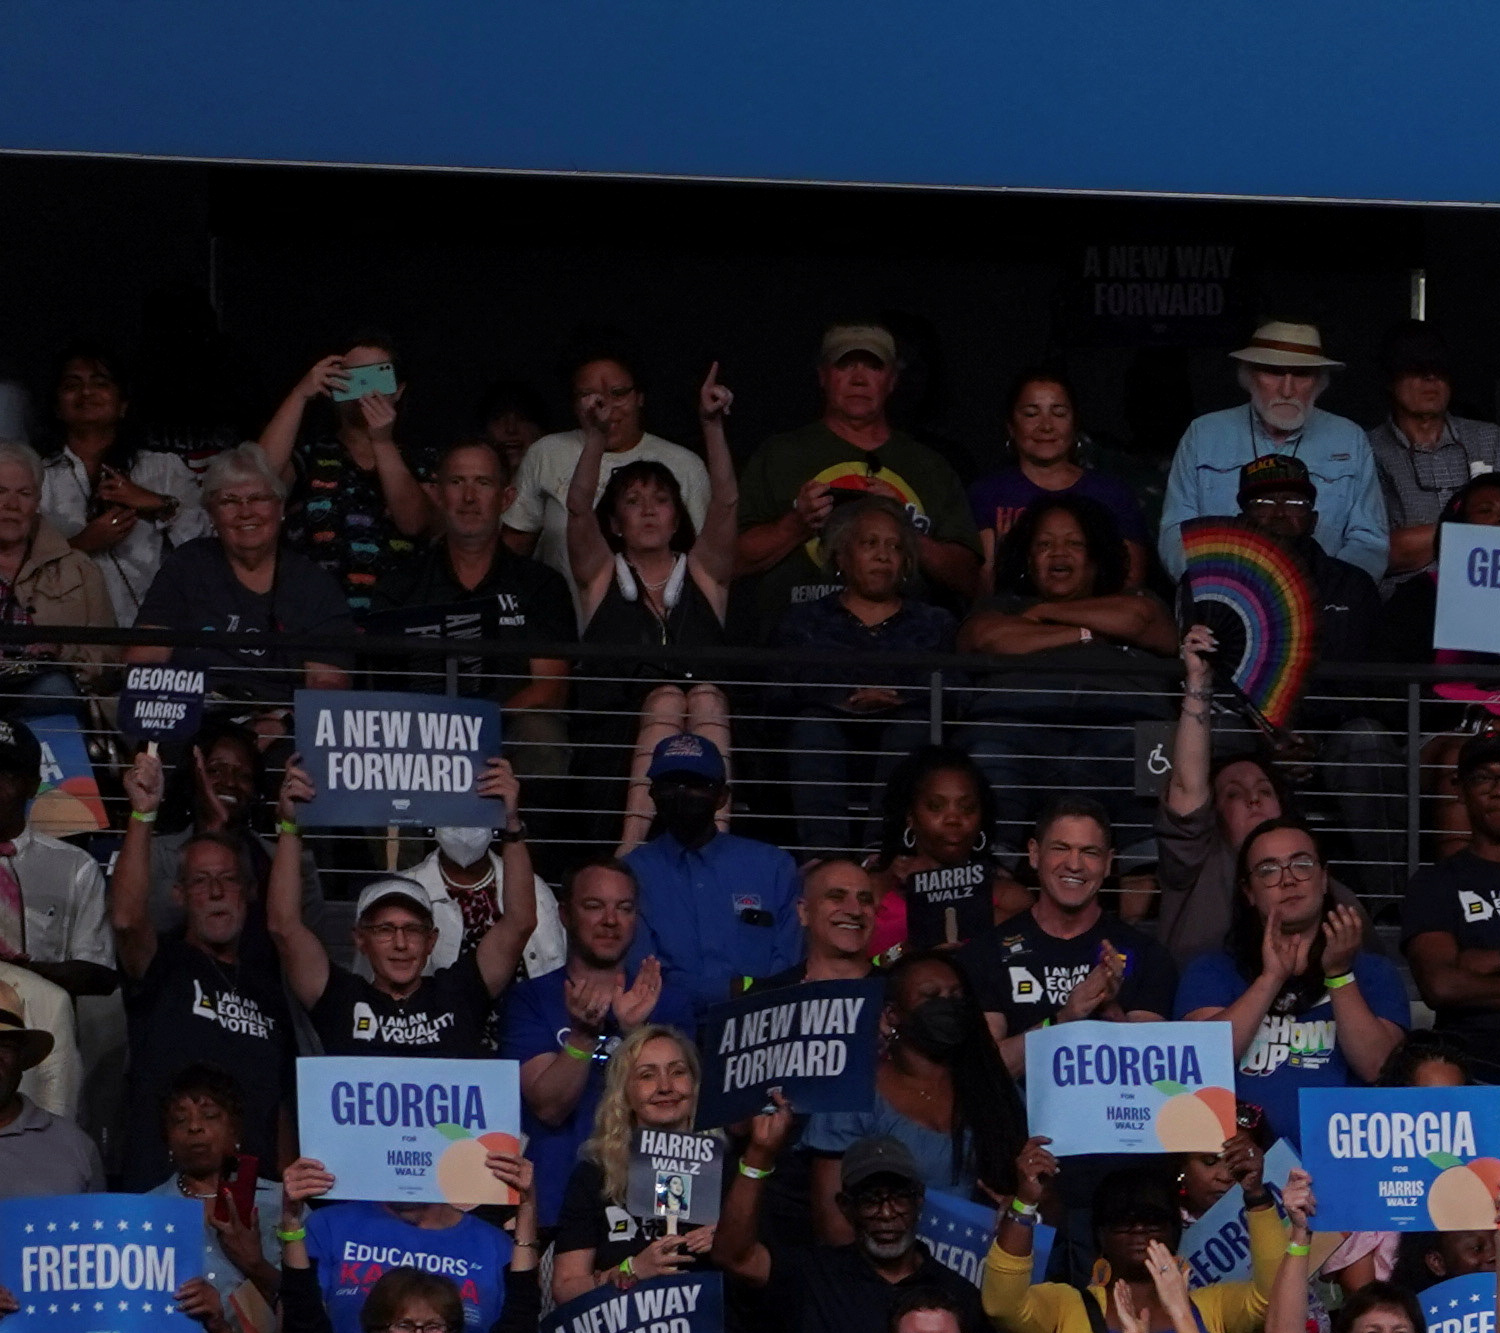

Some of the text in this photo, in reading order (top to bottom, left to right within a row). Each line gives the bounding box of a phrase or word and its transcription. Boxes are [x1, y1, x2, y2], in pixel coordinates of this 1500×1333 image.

[1084, 247, 1233, 279] A NEW WAY
[1094, 283, 1224, 315] FORWARD
[127, 667, 205, 696] GEORGIA
[134, 698, 187, 721] HARRIS
[141, 718, 177, 730] WALZ
[719, 998, 865, 1054] A NEW WAY
[723, 1038, 848, 1093] FORWARD
[1053, 1045, 1202, 1086] GEORGIA
[330, 1082, 487, 1127] GEORGIA
[1106, 1105, 1151, 1123] HARRIS
[1115, 1121, 1145, 1130] WALZ
[1328, 1111, 1476, 1158] GEORGIA
[386, 1149, 432, 1167] HARRIS
[640, 1131, 714, 1162] HARRIS
[395, 1167, 427, 1177] WALZ
[651, 1156, 701, 1175] WALZ
[1379, 1180, 1425, 1198] HARRIS
[1386, 1198, 1418, 1207] WALZ
[22, 1244, 176, 1291] FREEDOM
[343, 1241, 468, 1276] EDUCATORS
